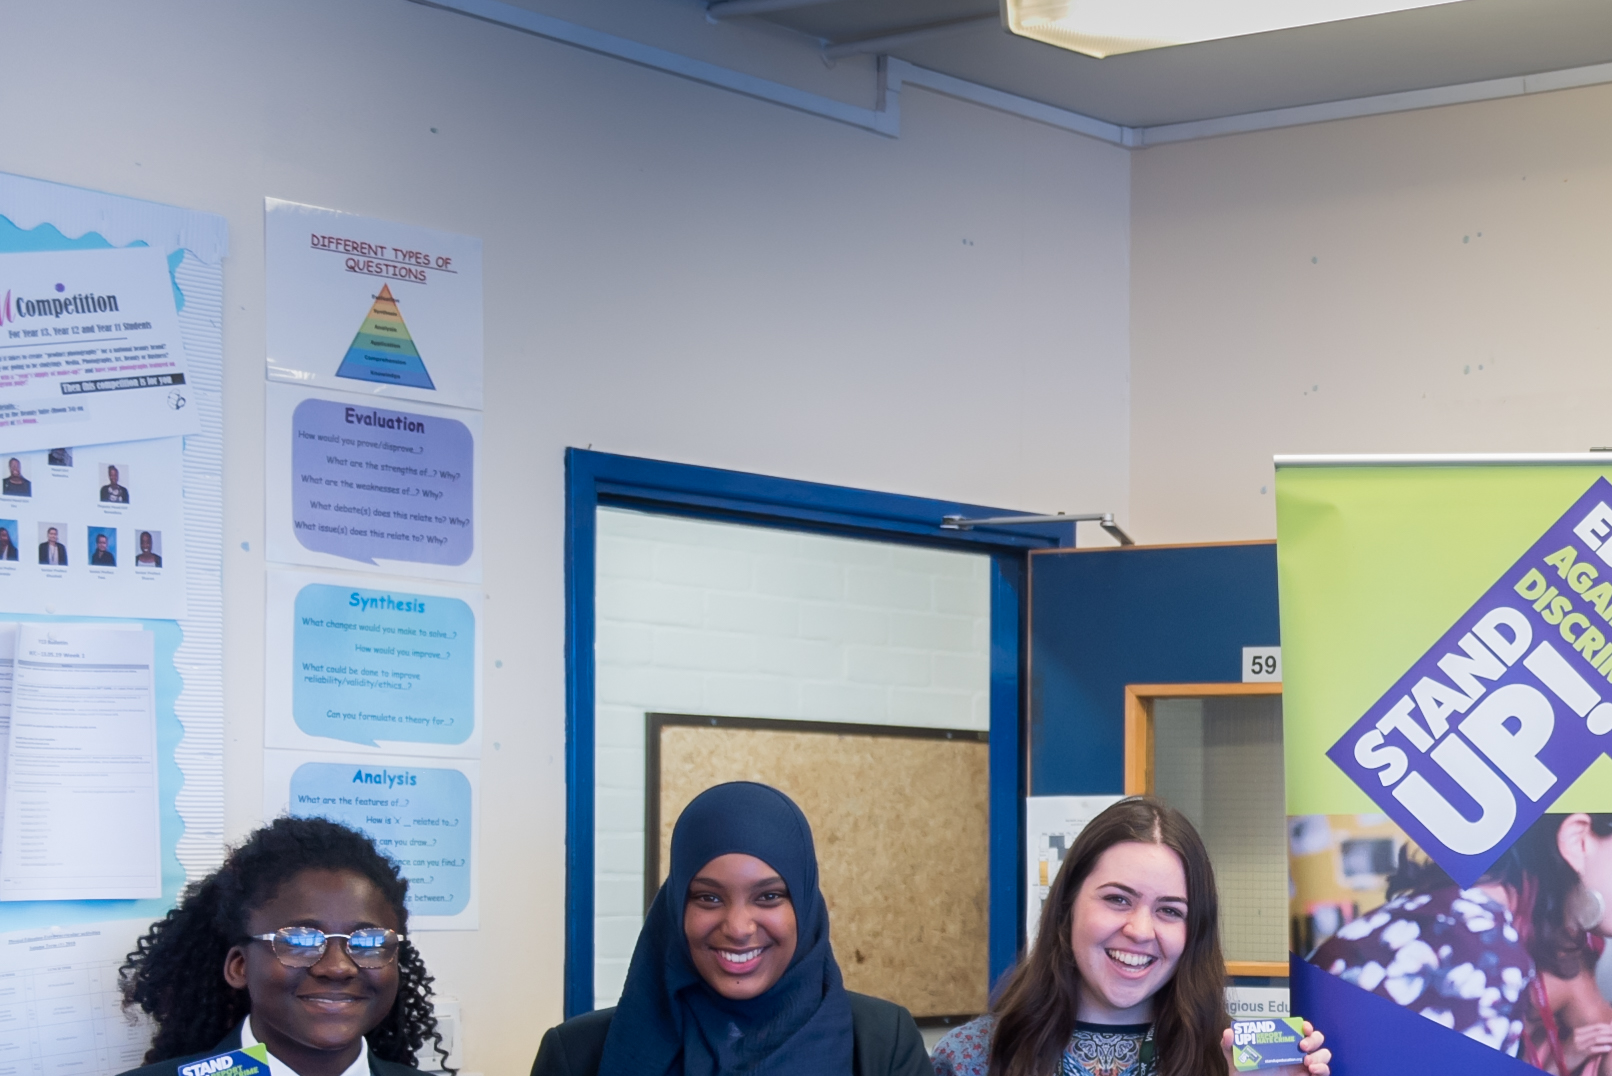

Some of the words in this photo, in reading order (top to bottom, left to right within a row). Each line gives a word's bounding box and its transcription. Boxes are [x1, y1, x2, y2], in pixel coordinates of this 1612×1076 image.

[310, 232, 388, 258] DIFFERENT
[391, 247, 431, 267] TYPES
[434, 256, 453, 270] OF
[344, 256, 428, 282] QUESTIONS
[15, 293, 120, 319] Competition
[344, 406, 426, 435] Evaluation
[298, 430, 316, 442] How
[318, 434, 341, 445] would
[341, 437, 356, 449] you
[309, 499, 332, 512] What
[334, 503, 372, 518] debate(s)
[372, 508, 392, 519] does
[392, 510, 409, 521] this
[408, 512, 433, 523] relate
[434, 515, 447, 525] to?
[448, 515, 471, 529] Why?
[294, 519, 317, 532] What
[317, 523, 349, 537] issue(s)
[349, 527, 368, 538] does
[369, 529, 386, 540] this
[386, 531, 410, 542] relate
[411, 534, 425, 545] to?
[425, 534, 449, 548] Why?
[348, 591, 426, 614] Synthesis
[301, 616, 324, 628] What
[325, 619, 358, 633] changes
[358, 623, 381, 634] would
[381, 626, 397, 637] you
[397, 626, 418, 638] make
[418, 628, 428, 638] to
[301, 662, 325, 673] What
[325, 664, 348, 676] could
[348, 666, 360, 677] be
[360, 667, 380, 680] done
[380, 669, 391, 680] to
[390, 669, 422, 684] improve
[1251, 655, 1277, 675] 59
[1353, 605, 1534, 788] STAND
[351, 768, 418, 790] Analysis
[297, 795, 322, 806] What
[322, 797, 338, 806] are
[338, 796, 354, 807] the
[354, 797, 390, 808] features
[1233, 1020, 1276, 1035] STAND
[1234, 1032, 1257, 1046] UP!
